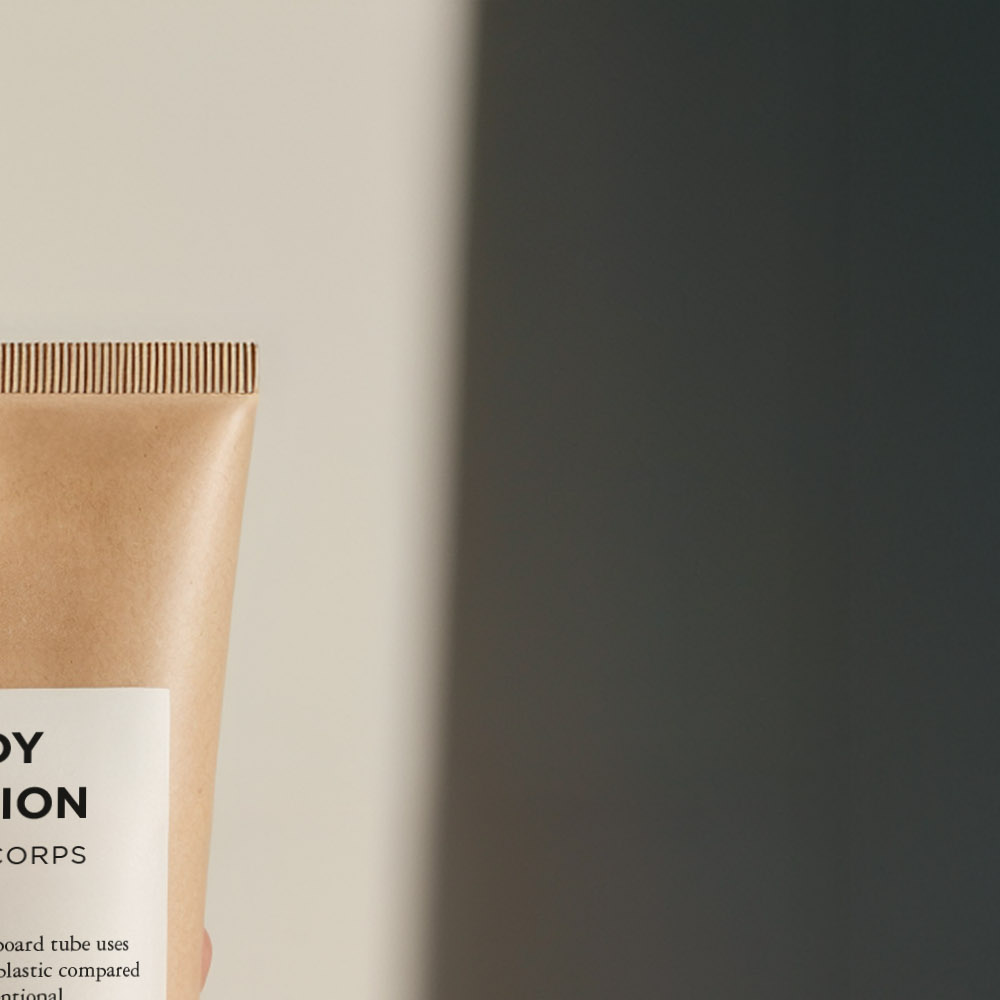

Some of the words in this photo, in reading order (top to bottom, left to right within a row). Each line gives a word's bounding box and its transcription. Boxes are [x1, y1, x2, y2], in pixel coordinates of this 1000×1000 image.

[51, 935, 91, 952] tube
[96, 938, 129, 951] uses
[58, 961, 141, 982] compared
